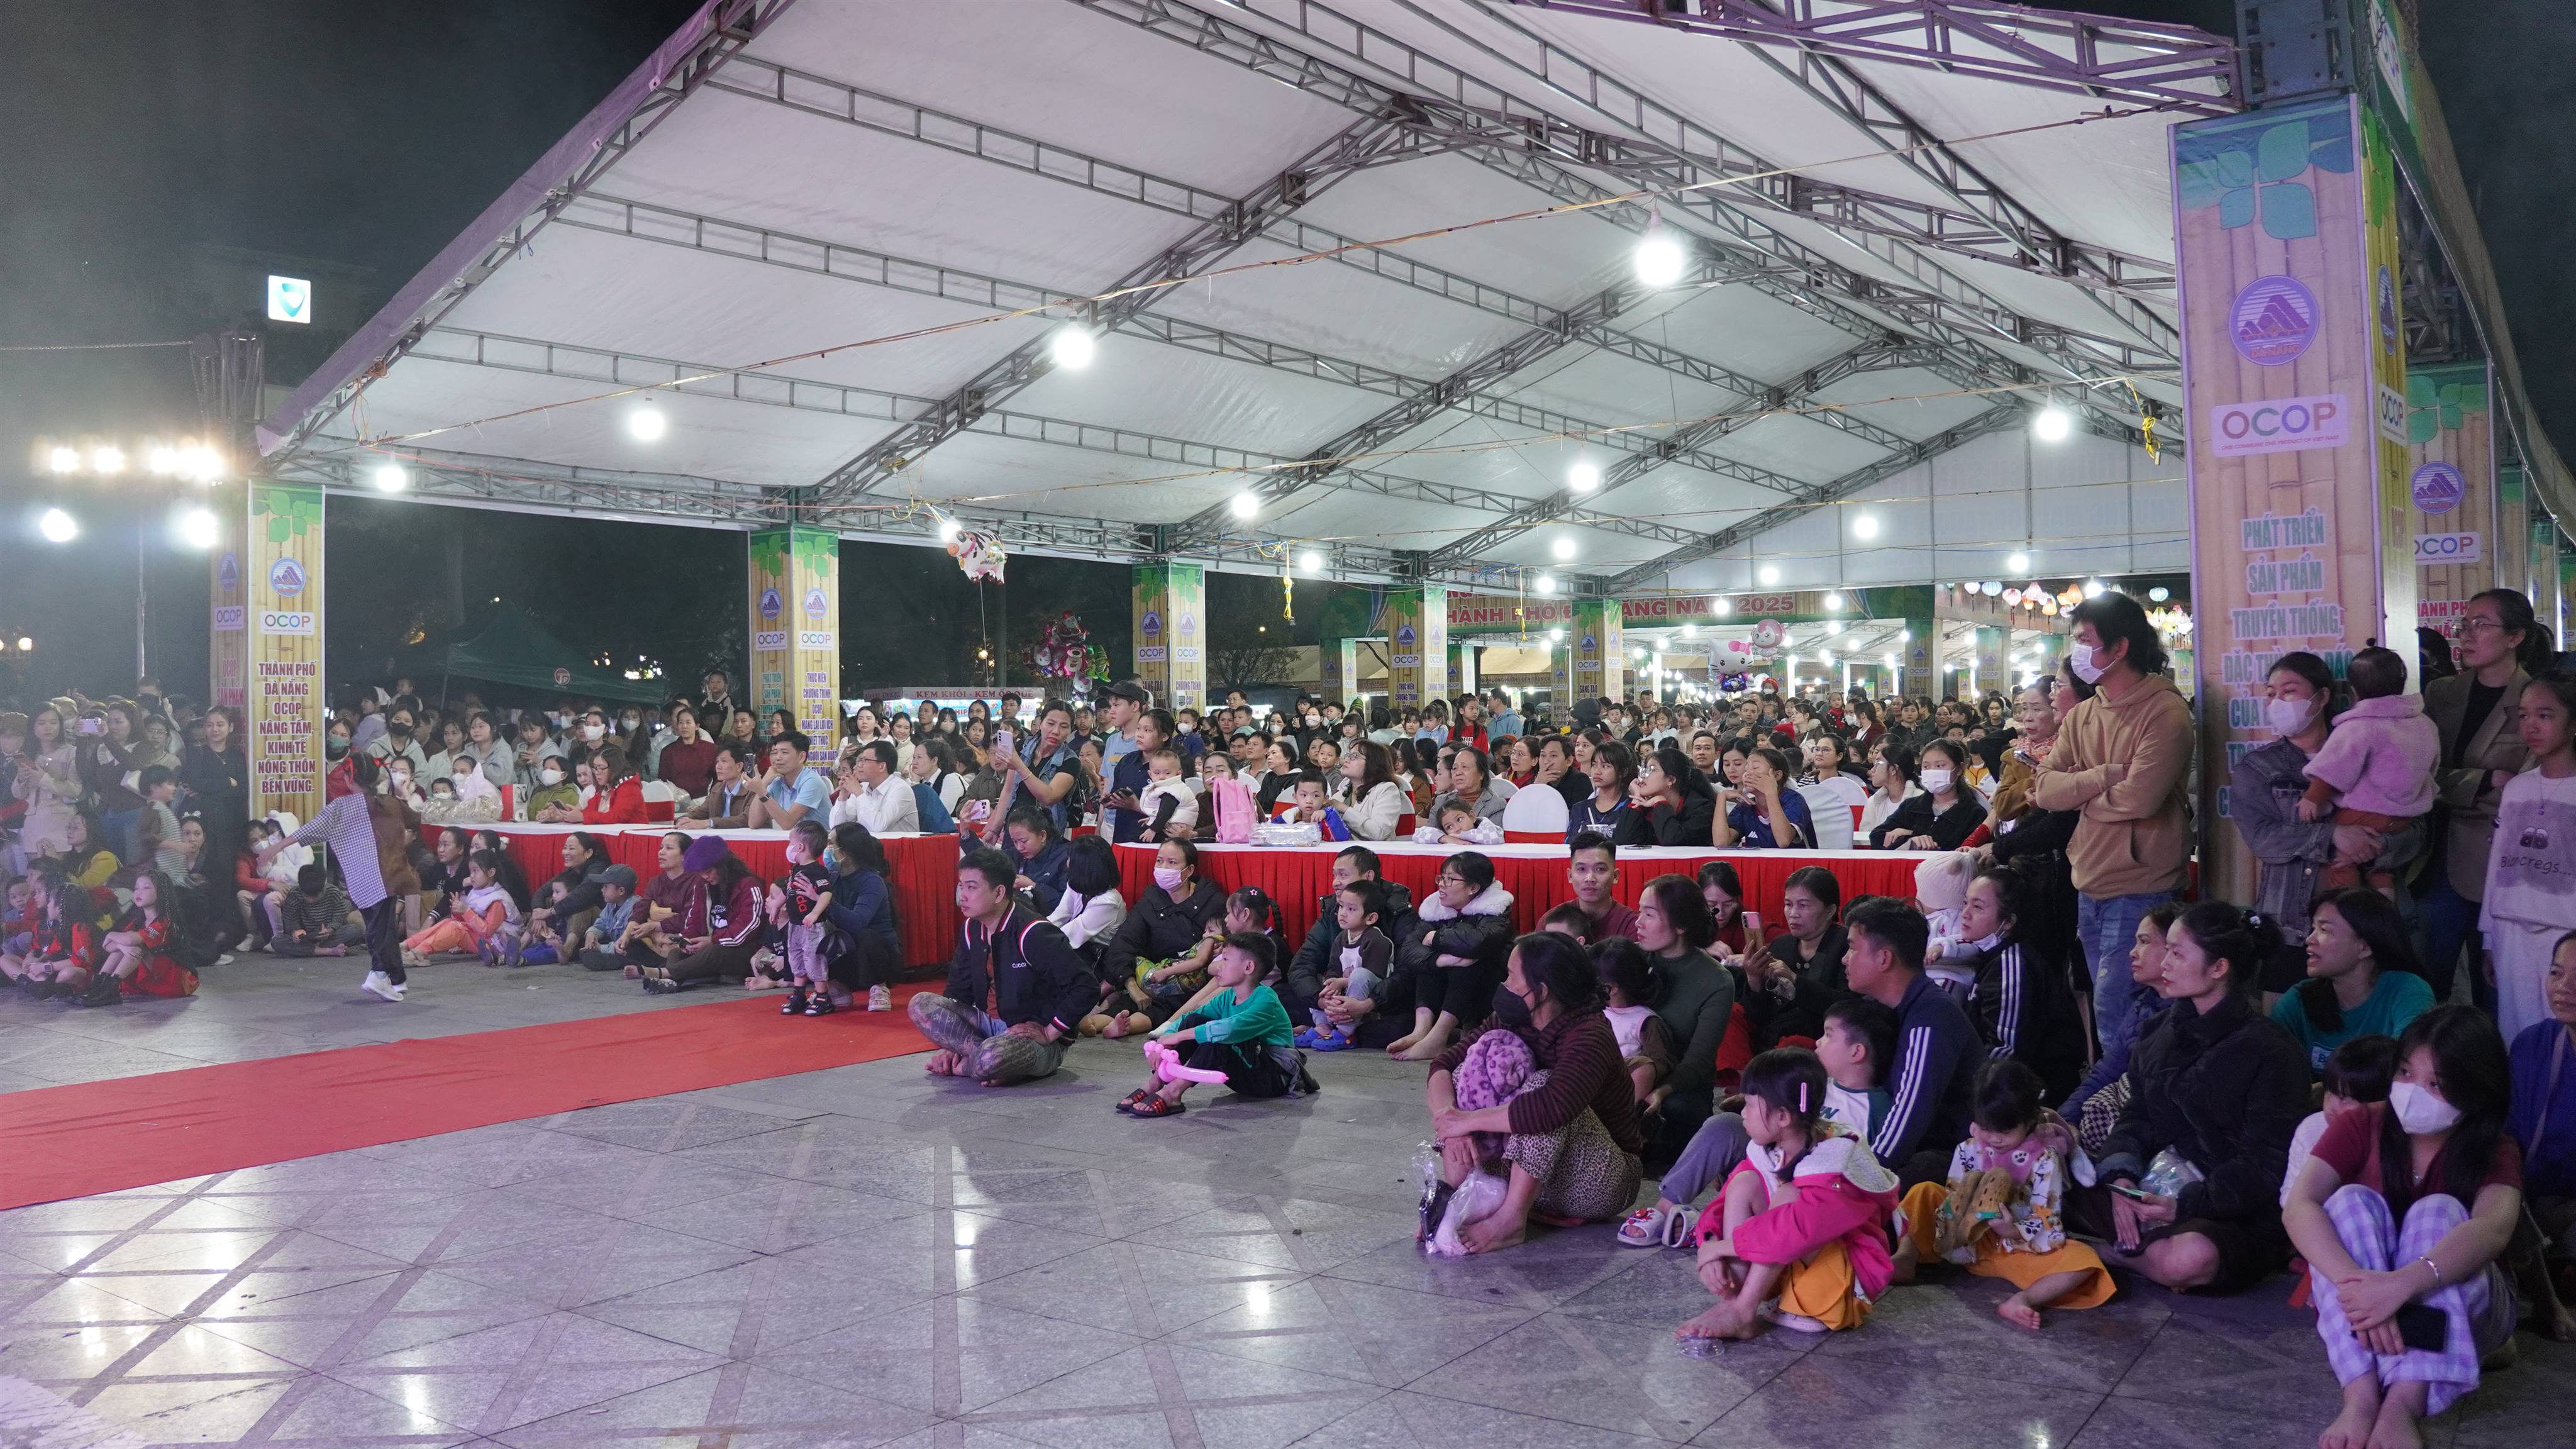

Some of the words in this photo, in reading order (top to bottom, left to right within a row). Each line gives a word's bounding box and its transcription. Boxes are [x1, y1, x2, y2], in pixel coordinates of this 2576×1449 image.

[2381, 391, 2404, 428] OCOP
[2221, 402, 2336, 439] OCOP
[2243, 513, 2280, 549] PHÁT
[2282, 507, 2325, 546] TRIỂN
[2248, 555, 2277, 593] SẢN
[2280, 553, 2323, 591] PHẨM
[217, 609, 242, 623] OCOP
[1447, 604, 1504, 623] HÀNH
[1676, 597, 1718, 615] NĂ
[1737, 596, 1794, 613] 2025
[2418, 600, 2448, 617] ÀNH
[2451, 601, 2469, 616] PH
[265, 614, 310, 628] OCOP
[2233, 601, 2287, 638] TRUYỀN
[758, 633, 785, 645] OCOP
[801, 633, 831, 644] OCOP
[1140, 648, 1164, 657] OCOP
[1177, 648, 1198, 657] OCOP
[223, 659, 237, 679] OCOP
[258, 660, 293, 675] THÀNH
[296, 660, 317, 676] PHỐ
[265, 680, 278, 695] ĐÀ
[281, 678, 308, 696] NẴNG
[941, 689, 967, 697] KHÓI
[274, 702, 302, 715] OCOP
[812, 704, 823, 714] OCOP
[2231, 689, 2260, 727] CỦA
[260, 719, 287, 735] NÂNG
[268, 741, 292, 753] KINH
[294, 738, 307, 753] TẾ
[258, 758, 286, 774] NÔNG
[289, 758, 316, 773] THÔN
